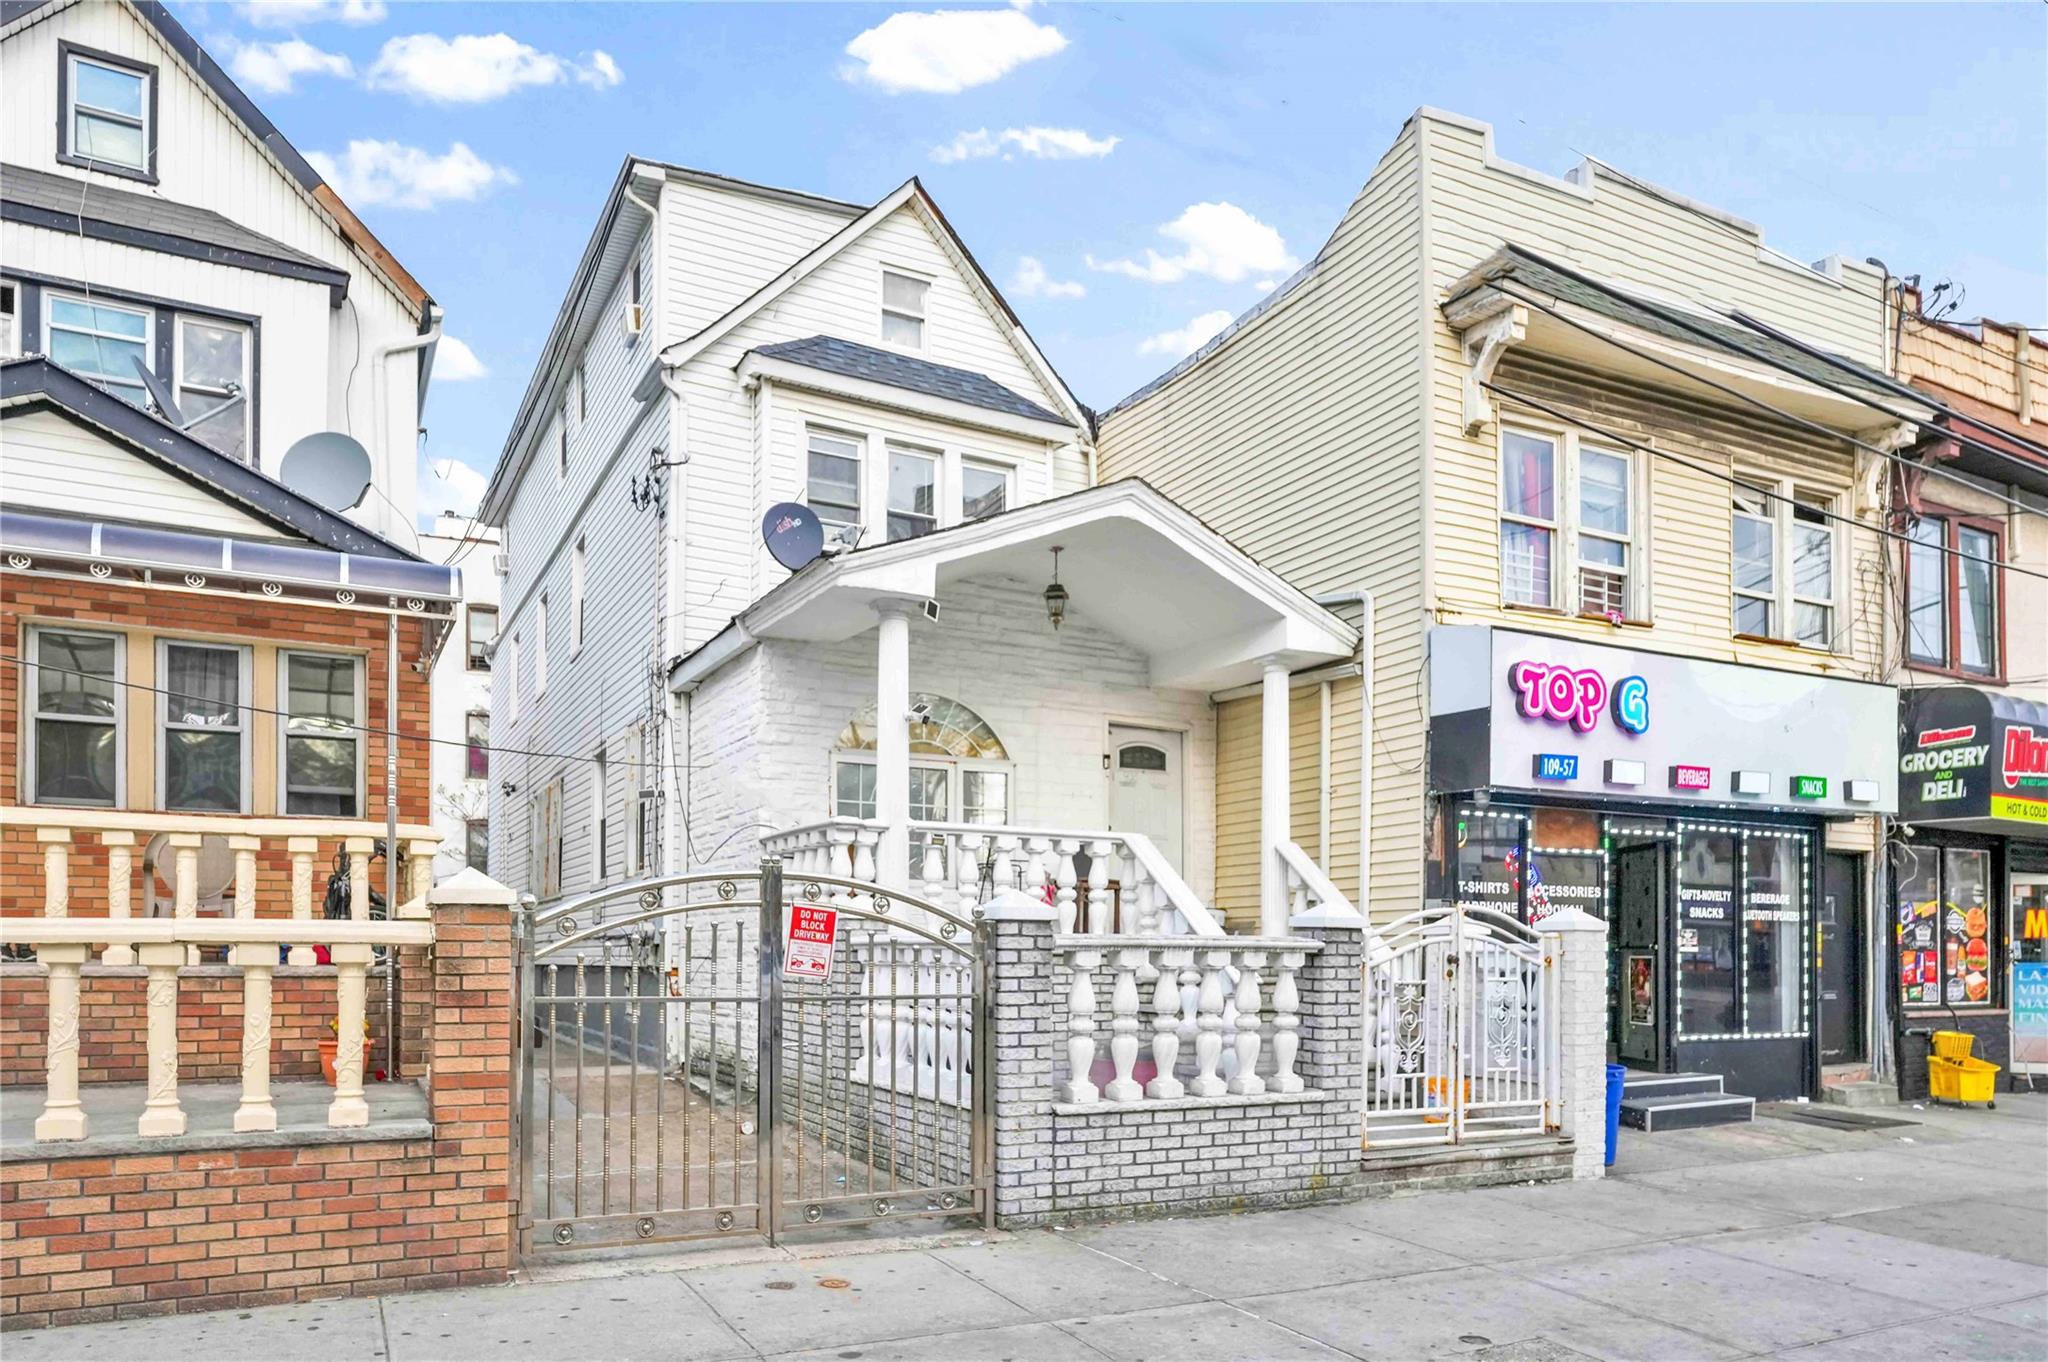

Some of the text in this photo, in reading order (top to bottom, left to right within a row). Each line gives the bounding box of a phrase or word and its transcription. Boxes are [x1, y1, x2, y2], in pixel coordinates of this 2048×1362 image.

[1517, 661, 1649, 734] TOP G
[1900, 745, 1990, 773] GROCERY
[1543, 758, 1575, 776] 109-57
[1678, 769, 1709, 786] BEVERAGES
[1935, 771, 1953, 780] AND
[1802, 780, 1823, 795] SNACKS
[1921, 779, 1964, 802] DELI
[2007, 803, 2047, 818] HOT & COLD
[1458, 881, 1510, 894] T-SHIRTS
[800, 910, 828, 921] DO NOT
[1689, 907, 1724, 919] SNACKS
[801, 920, 825, 931] BLOCK
[794, 929, 829, 940] DRIVEWAY
